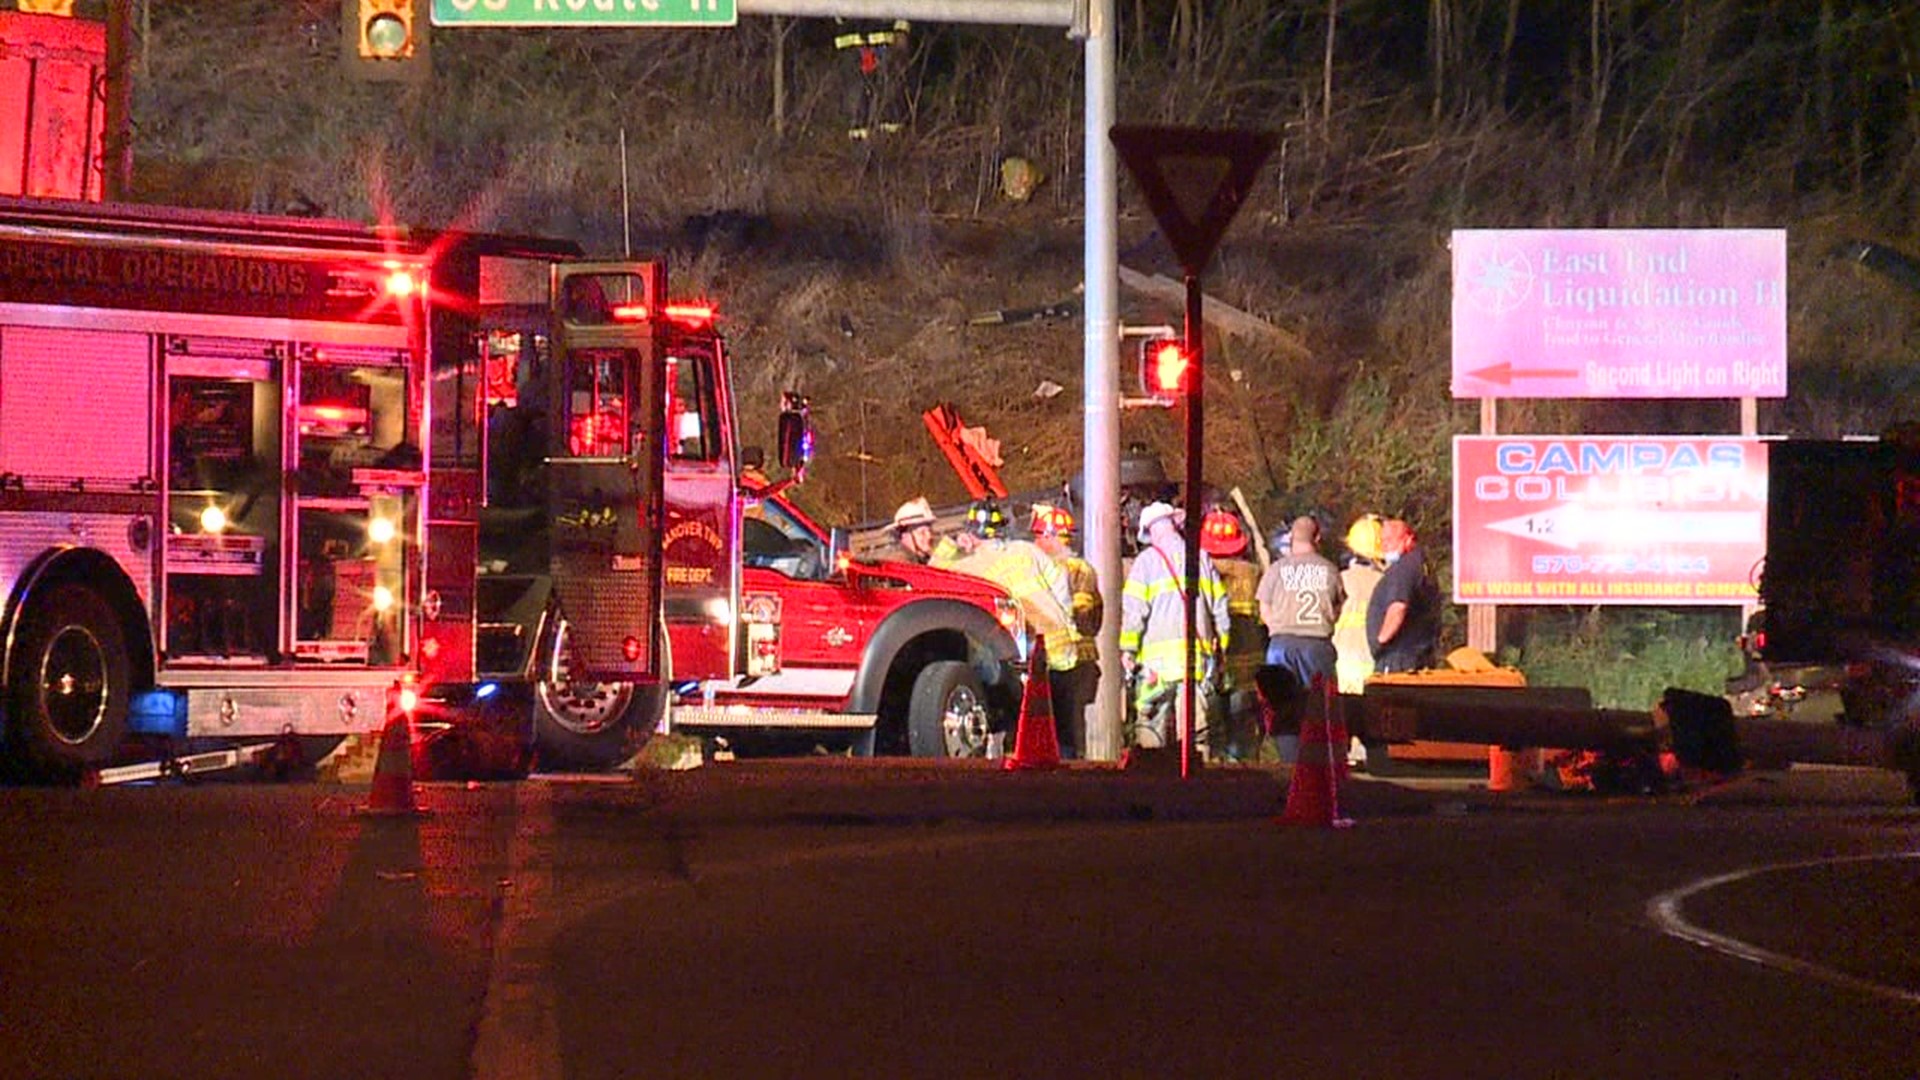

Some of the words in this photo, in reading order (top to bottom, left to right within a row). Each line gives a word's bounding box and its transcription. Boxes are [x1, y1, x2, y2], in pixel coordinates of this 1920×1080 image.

[0, 244, 110, 281] PECIAL
[122, 252, 306, 295] OPERATIONS
[1543, 248, 1608, 274] East
[1543, 280, 1739, 312] Liquidation
[1586, 361, 1650, 385] Second
[1656, 361, 1699, 390] Light
[1706, 367, 1727, 384] on
[1733, 360, 1779, 390] Right
[1497, 443, 1744, 475] CAMPAS
[667, 567, 687, 583] FIRE
[1461, 582, 1483, 596] WE
[1487, 582, 1532, 596] WORK
[1536, 582, 1577, 597] WITH
[1580, 582, 1604, 596] ALL
[1607, 582, 1692, 596] INSURANCE
[1296, 590, 1321, 624] 2
